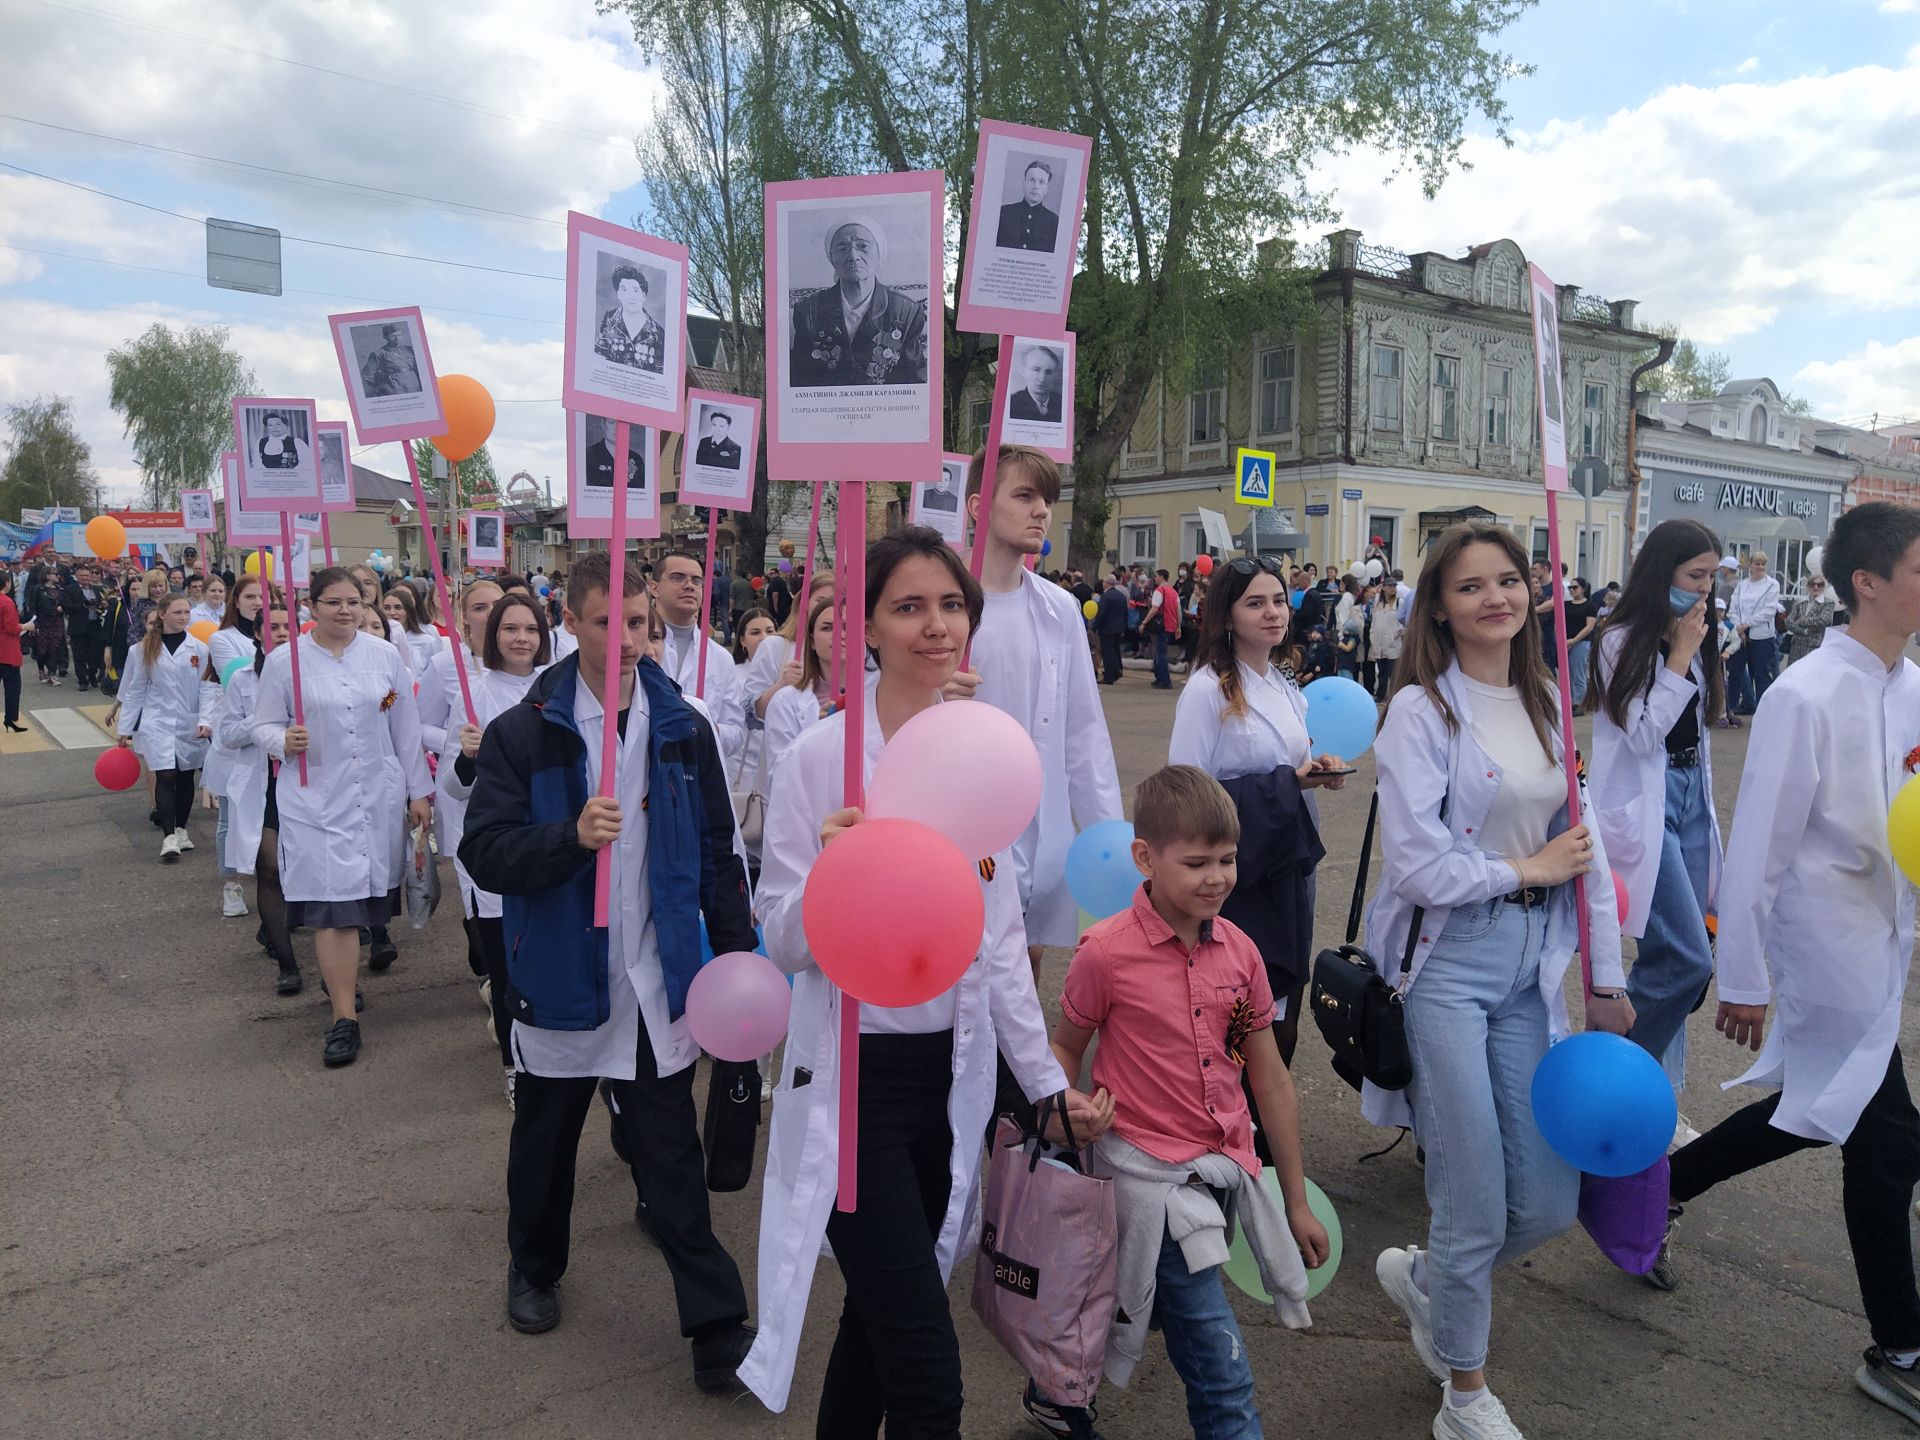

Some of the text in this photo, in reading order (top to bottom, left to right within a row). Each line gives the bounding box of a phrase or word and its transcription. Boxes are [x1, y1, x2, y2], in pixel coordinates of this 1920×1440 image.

[794, 389, 917, 399] АХМАТШИНА ДЖАМИЛЯ КАРАМОВНА
[836, 413, 872, 421] ГОСПИТАЛЯ
[1676, 482, 1785, 516] café AVENUE
[1792, 497, 1817, 519] кафе
